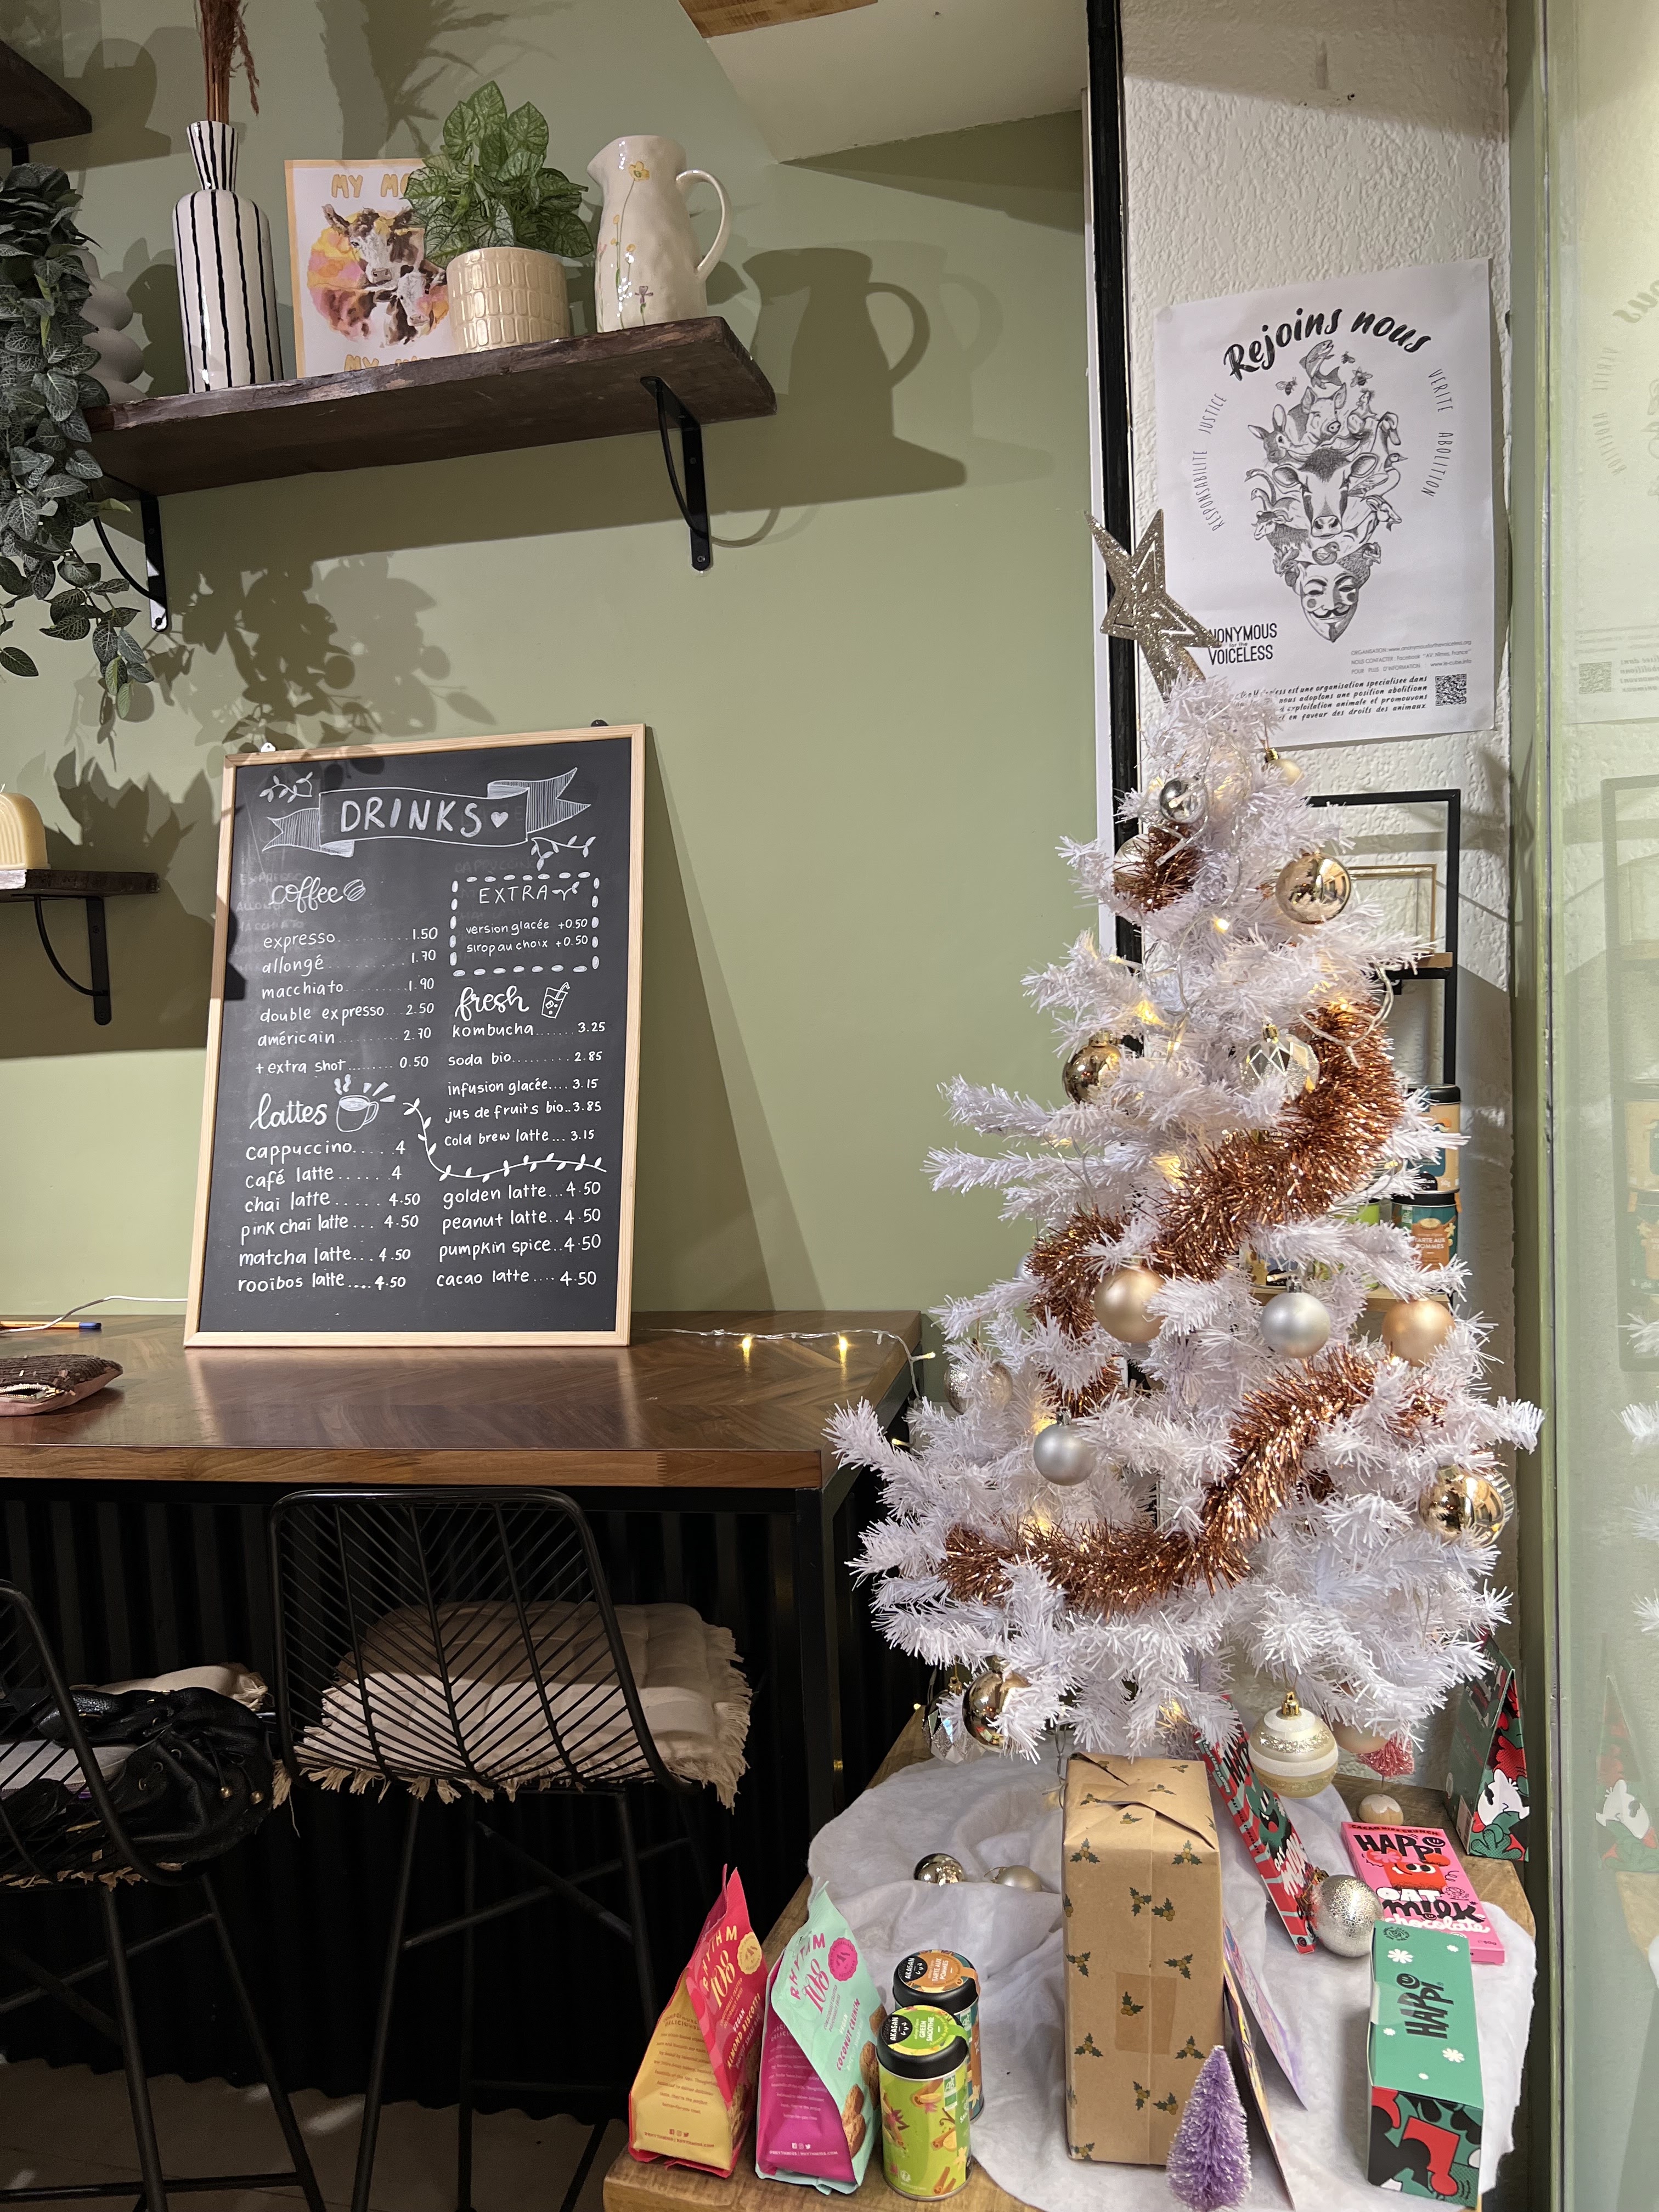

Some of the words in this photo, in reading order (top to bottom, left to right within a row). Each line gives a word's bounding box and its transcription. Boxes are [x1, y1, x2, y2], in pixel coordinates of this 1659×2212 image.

[331, 174, 363, 198] MY
[1223, 308, 1343, 381] Rejoins
[1351, 309, 1431, 353] nous
[1428, 368, 1453, 412] VERITE
[1198, 393, 1227, 435] JUSTICE
[1420, 432, 1453, 497] ABOLITION
[1192, 450, 1225, 531] RESPONSABILITE
[1207, 644, 1273, 665] VOICELESS
[1288, 686, 1299, 695] est
[1316, 681, 1364, 692] organisation
[1299, 694, 1333, 703] adoptons
[1353, 688, 1384, 698] position
[1381, 694, 1427, 706] promouvons
[1301, 712, 1328, 721] faveur
[1348, 707, 1372, 715] droits
[341, 797, 483, 838] DRINKS
[268, 876, 343, 913] coffee
[479, 884, 548, 904] EXTRA
[465, 922, 508, 934] version
[511, 918, 550, 935] glacée
[558, 918, 588, 929] +0.50
[263, 933, 335, 953] expresso
[413, 927, 438, 940] 1.50
[466, 944, 495, 957] sirop
[497, 943, 512, 952] au
[516, 939, 548, 950] choix
[555, 935, 588, 947] +0.50
[262, 954, 324, 977] allongé
[411, 949, 436, 963] 1.70
[262, 980, 343, 1000] macchiato
[409, 978, 435, 991] 1.90
[260, 1007, 311, 1023] double
[321, 1006, 385, 1026] expresso
[405, 1002, 435, 1015] 2.50
[454, 985, 529, 1022] fresh
[257, 1030, 335, 1047] américain
[403, 1026, 431, 1041] 2.70
[452, 1022, 533, 1038] kombucha
[578, 1022, 606, 1033] 3.25
[268, 1059, 307, 1074] extra
[315, 1059, 346, 1072] shot
[399, 1056, 428, 1068] 0.50
[448, 1053, 482, 1066] soda
[492, 1052, 511, 1065] bio
[574, 1051, 603, 1062] 2.85
[448, 1081, 504, 1098] infusion
[508, 1077, 548, 1096] glacée
[572, 1078, 599, 1090] 3.15
[249, 1093, 328, 1130] lattes
[445, 1109, 470, 1124] jus
[474, 1107, 490, 1119] de
[493, 1103, 539, 1119] fruits
[546, 1101, 563, 1114] bio
[572, 1101, 601, 1112] 3.85
[444, 1133, 472, 1146] cold
[478, 1132, 510, 1144] brew
[516, 1128, 549, 1142] latte
[571, 1129, 595, 1141] 3.15
[246, 1140, 352, 1165] cappuccino
[395, 1140, 406, 1155] 4
[245, 1169, 285, 1192] café
[297, 1166, 334, 1182] latte
[391, 1165, 402, 1180] 4
[291, 1191, 330, 1210] latte
[388, 1193, 420, 1207] 4.50
[443, 1188, 500, 1210] golden
[509, 1183, 546, 1199] latte
[566, 1181, 601, 1197] 4.50
[241, 1221, 275, 1246] pink
[318, 1214, 348, 1231] latte
[383, 1215, 419, 1228] 4.50
[442, 1213, 503, 1235] peanut
[511, 1209, 547, 1225] latte
[564, 1208, 601, 1224] 4.50
[239, 1249, 306, 1267] matcha
[314, 1245, 352, 1265] latte
[379, 1248, 411, 1262] 4.50
[439, 1242, 505, 1263] pumpkin
[511, 1239, 551, 1256] spice
[564, 1234, 601, 1252] 4.50
[312, 1272, 345, 1288] latte
[375, 1276, 406, 1291] 4.50
[436, 1273, 483, 1287] cacao
[492, 1269, 529, 1283] latte
[560, 1271, 596, 1286] 4.50
[1375, 1887, 1442, 1903] OAT
[905, 1957, 915, 1979] AKASAN
[939, 1960, 949, 1980] POMMES
[710, 1950, 735, 2011] 108
[802, 1959, 829, 2015] 108
[727, 2031, 743, 2069] ALMOND
[742, 1993, 760, 2032] BISCOTTI
[732, 2008, 746, 2032] VEGAN
[890, 2017, 899, 2041] AKASAN
[926, 2017, 934, 2042] SMOOTHIE
[837, 2029, 852, 2071] COCONUT
[849, 1998, 860, 2030] CRUNCH
